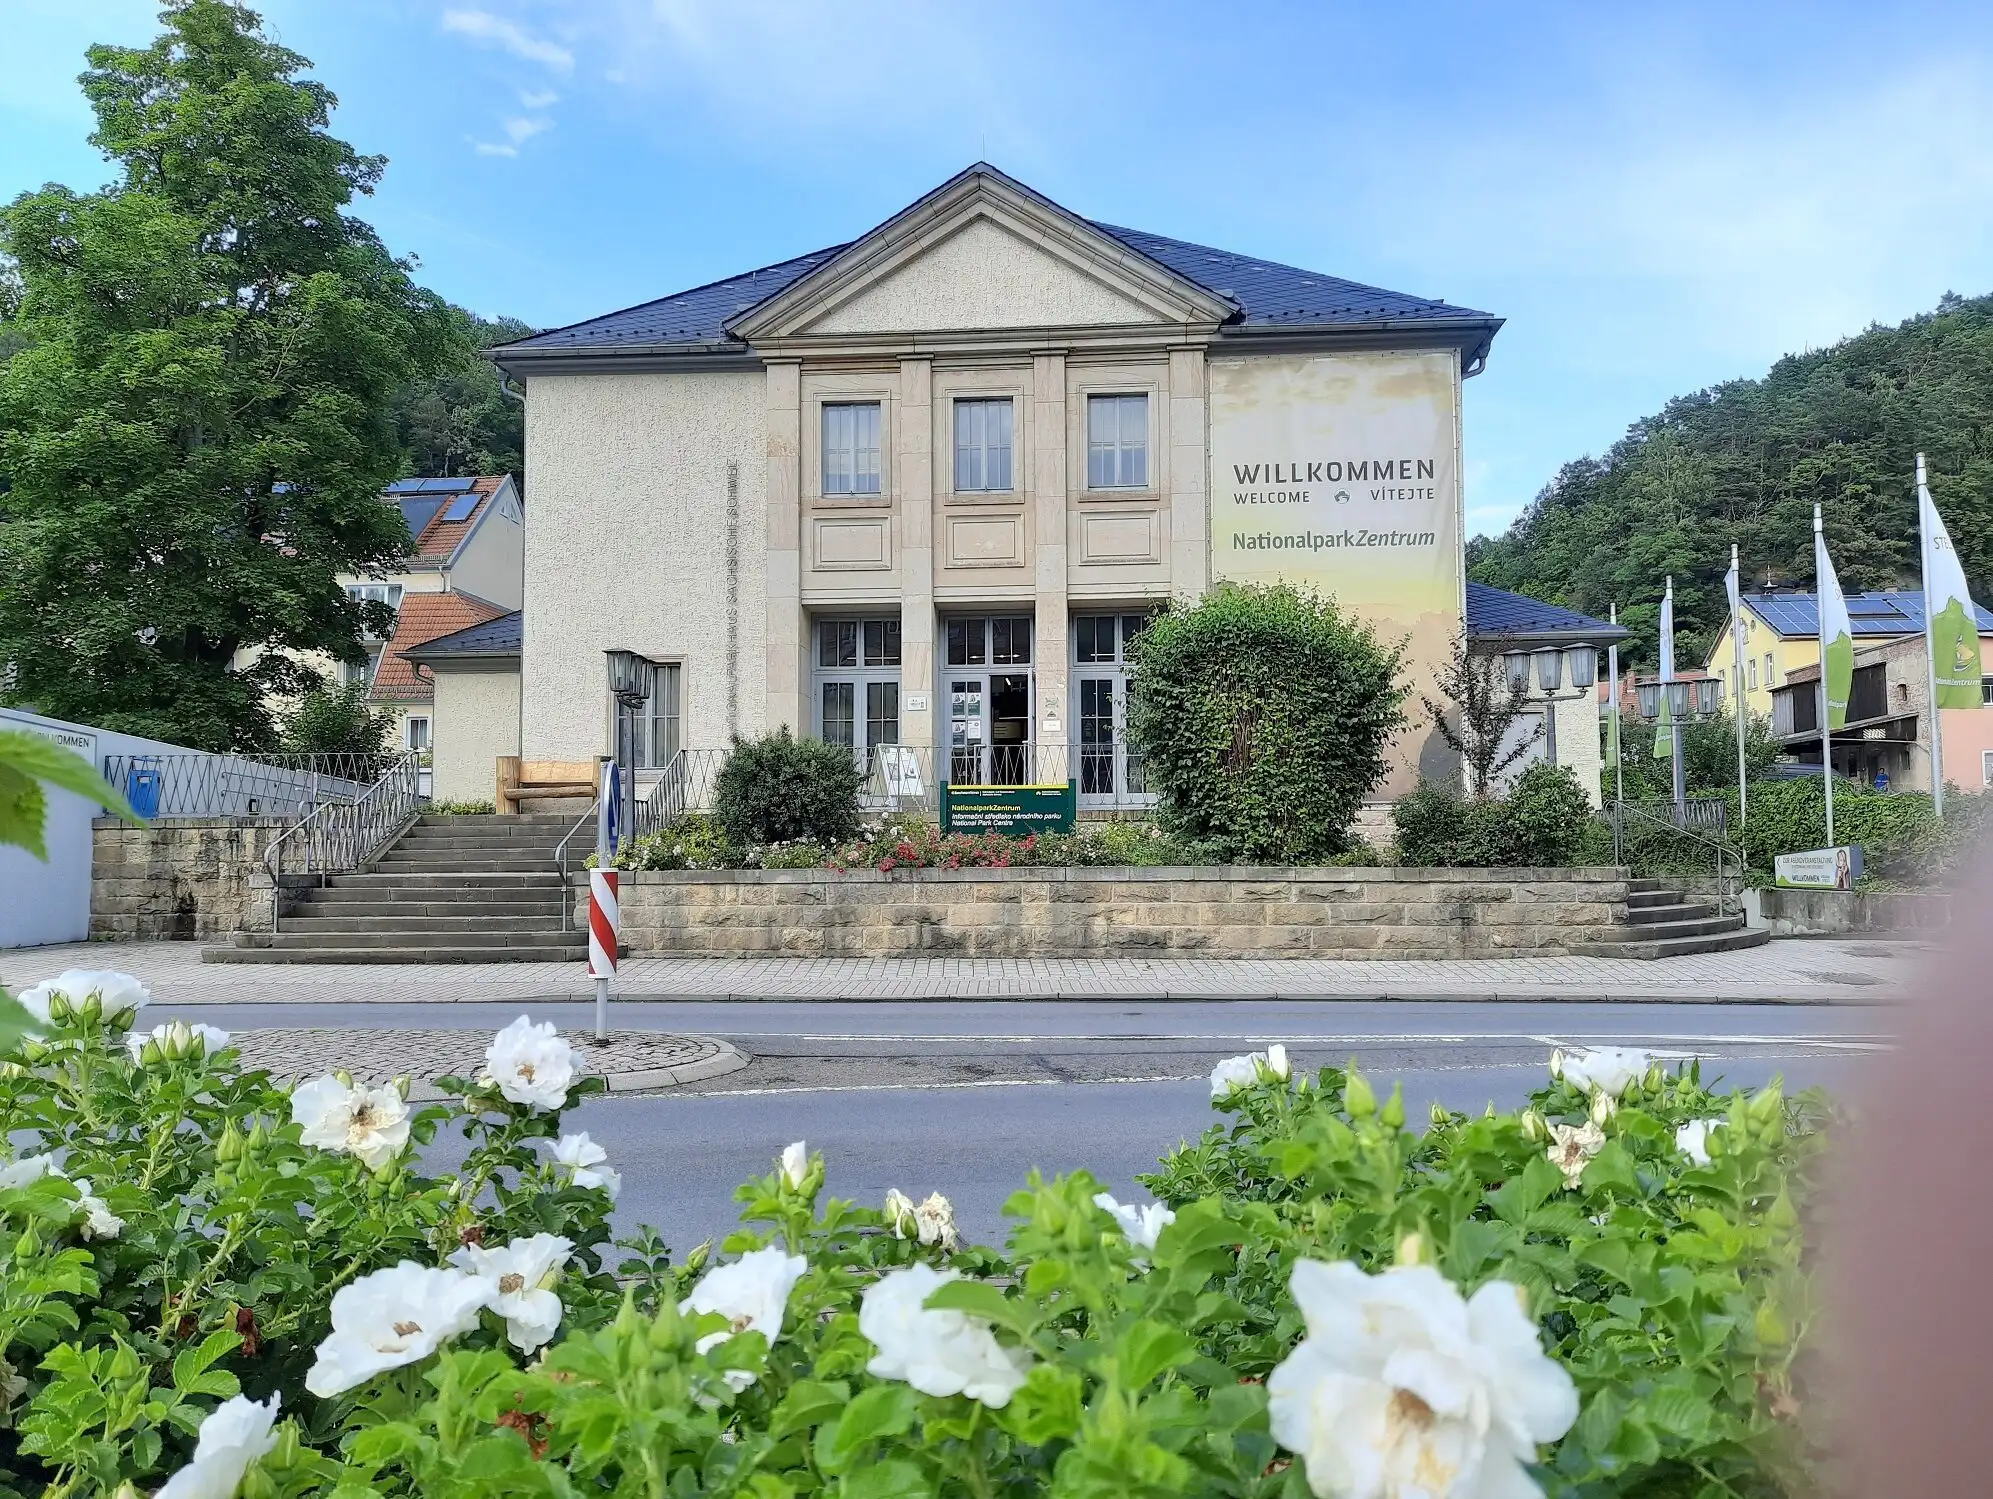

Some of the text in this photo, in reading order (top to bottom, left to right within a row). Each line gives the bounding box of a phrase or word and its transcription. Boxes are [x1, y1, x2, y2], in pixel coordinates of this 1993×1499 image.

[1233, 459, 1435, 485] WILLKOMMEN
[1233, 486, 1435, 505] WELCOME VÍTEJTE
[1233, 529, 1436, 552] NationalparkZentrum
[1044, 813, 1062, 821] parku
